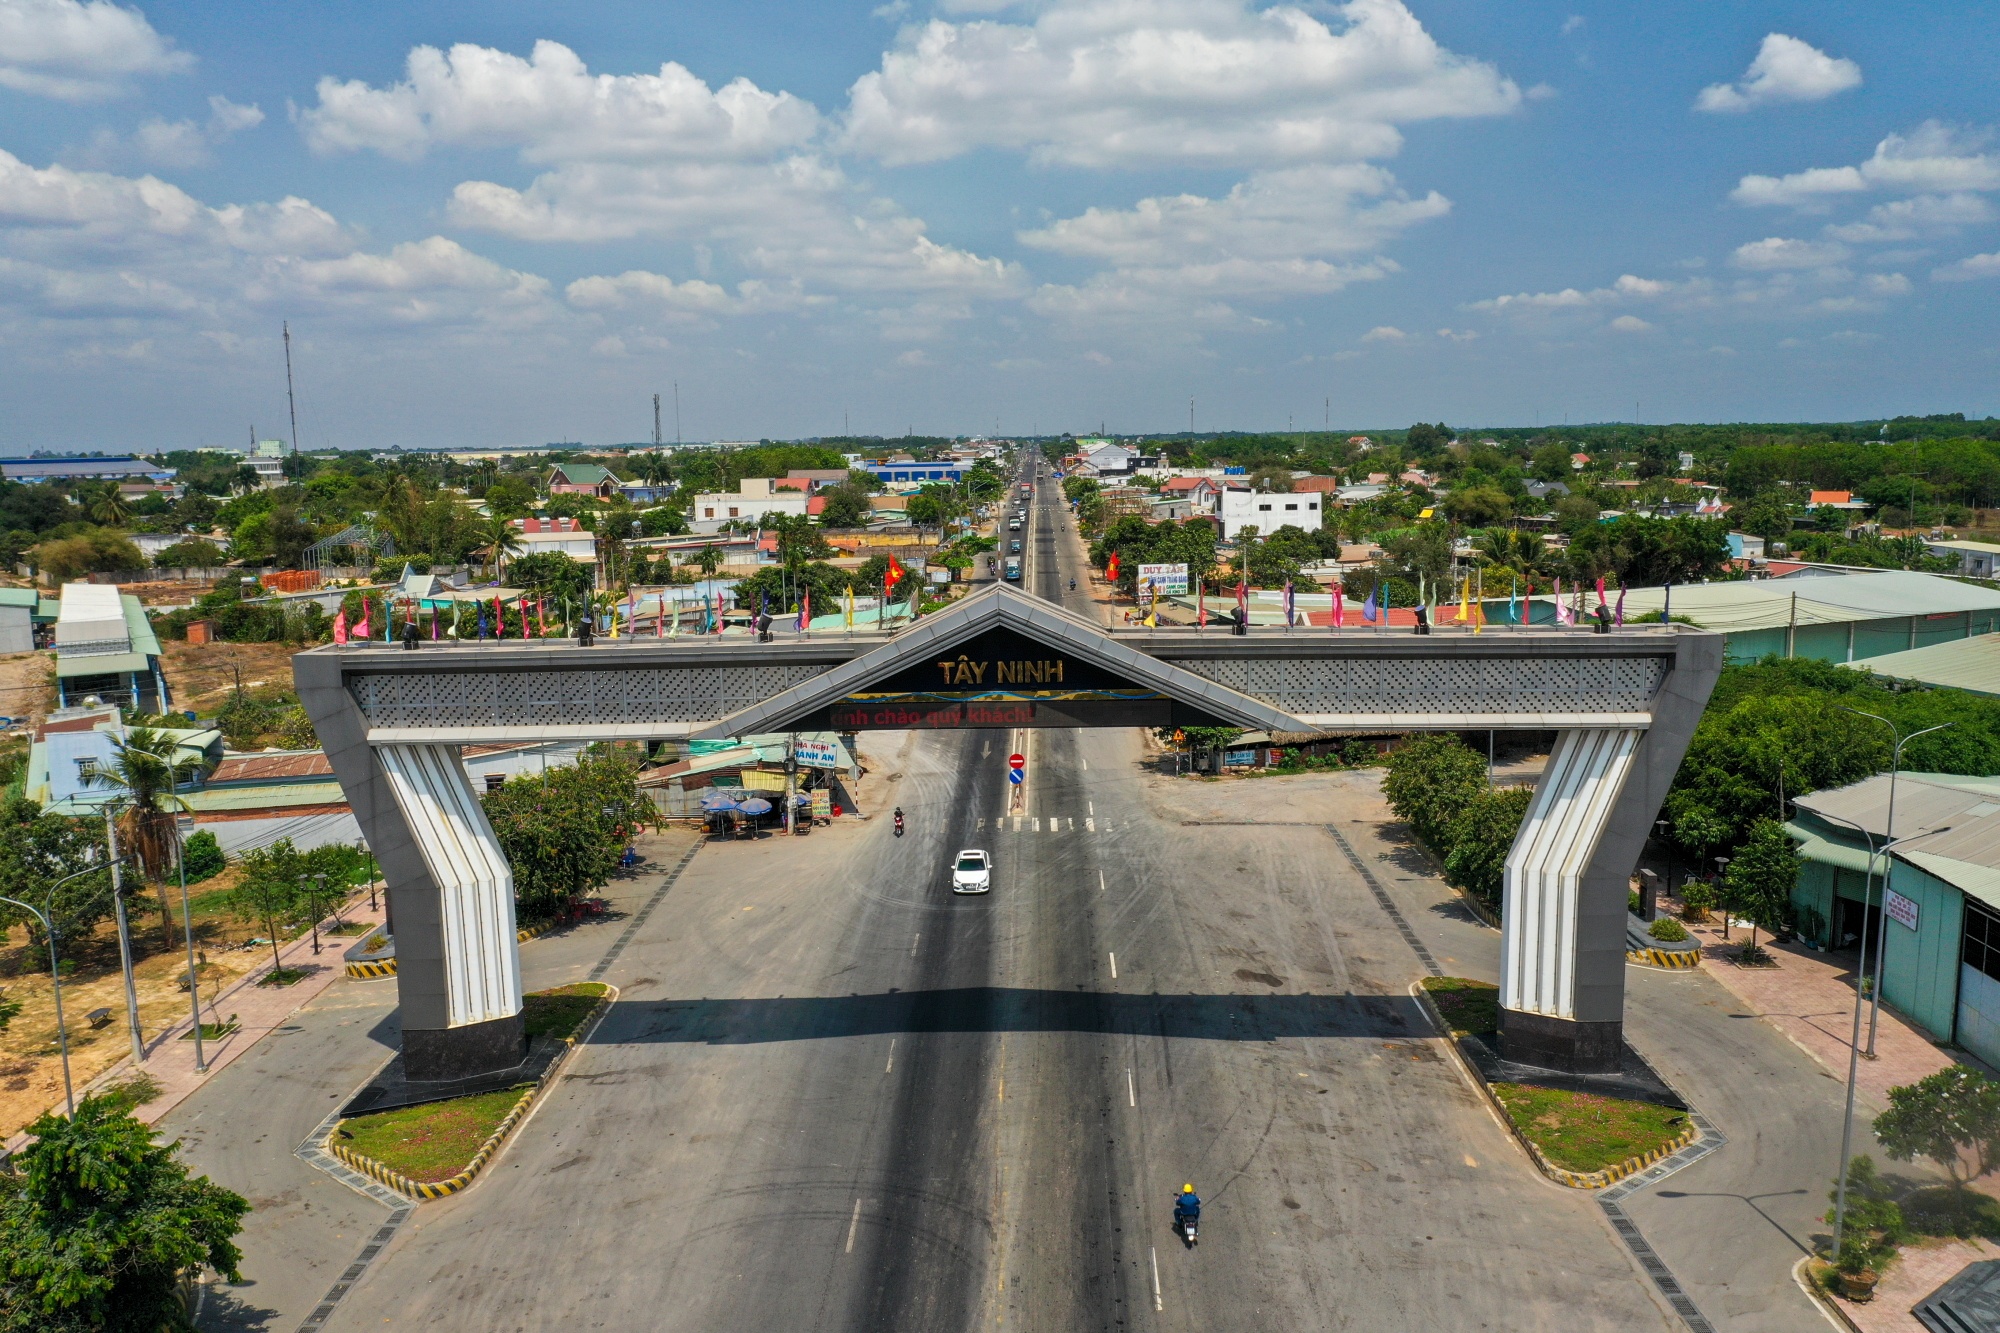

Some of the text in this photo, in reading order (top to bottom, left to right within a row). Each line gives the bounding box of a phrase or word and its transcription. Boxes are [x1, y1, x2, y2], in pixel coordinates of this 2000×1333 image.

[1143, 566, 1162, 575] DUY
[937, 655, 1063, 684] TÂY NINH
[874, 708, 921, 725] chào
[926, 708, 961, 727] quý
[821, 753, 835, 762] AN
